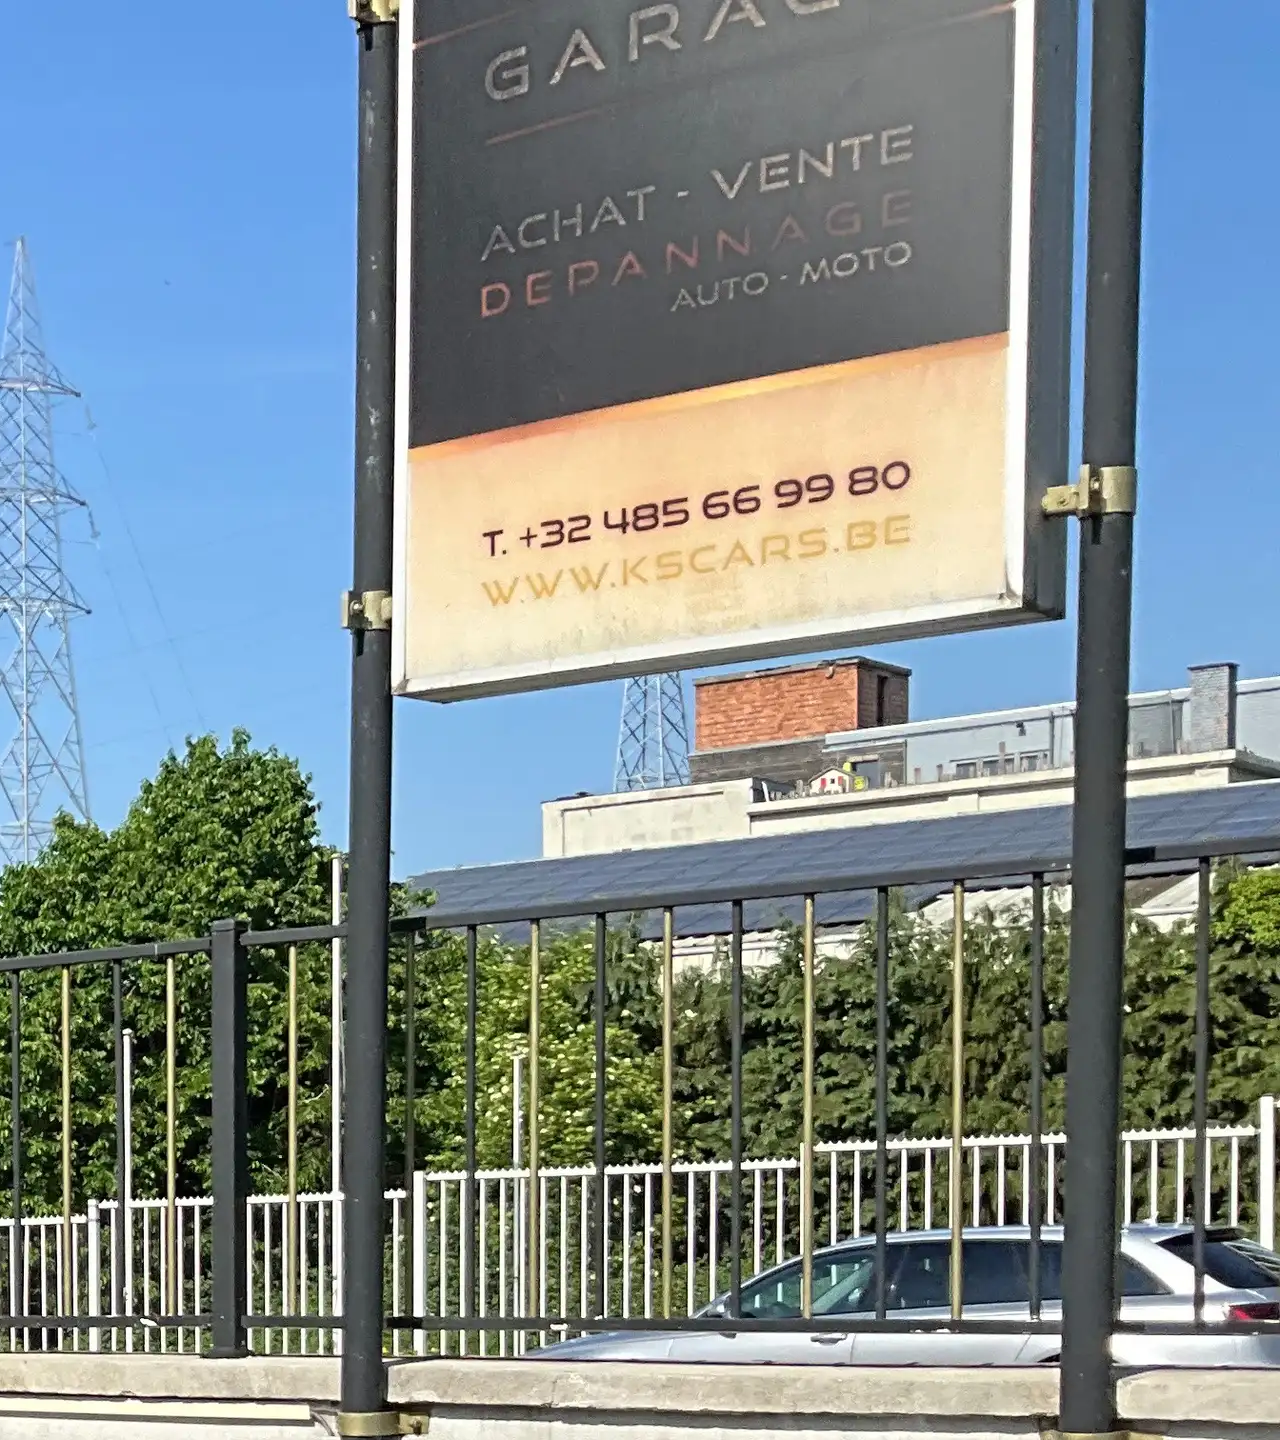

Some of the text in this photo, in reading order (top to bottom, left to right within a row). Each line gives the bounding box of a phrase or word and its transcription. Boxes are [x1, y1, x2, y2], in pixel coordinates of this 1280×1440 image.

[484, 0, 840, 101] GARA
[480, 185, 656, 262] ACHAT
[710, 124, 914, 199] VENTE
[480, 189, 912, 318] DEPANNAGE
[670, 272, 769, 312] AUTO
[799, 241, 913, 286] MOTO
[482, 460, 911, 557] T. +32 485 66 99 80
[481, 514, 911, 606] WWW.KSCARS.BE
